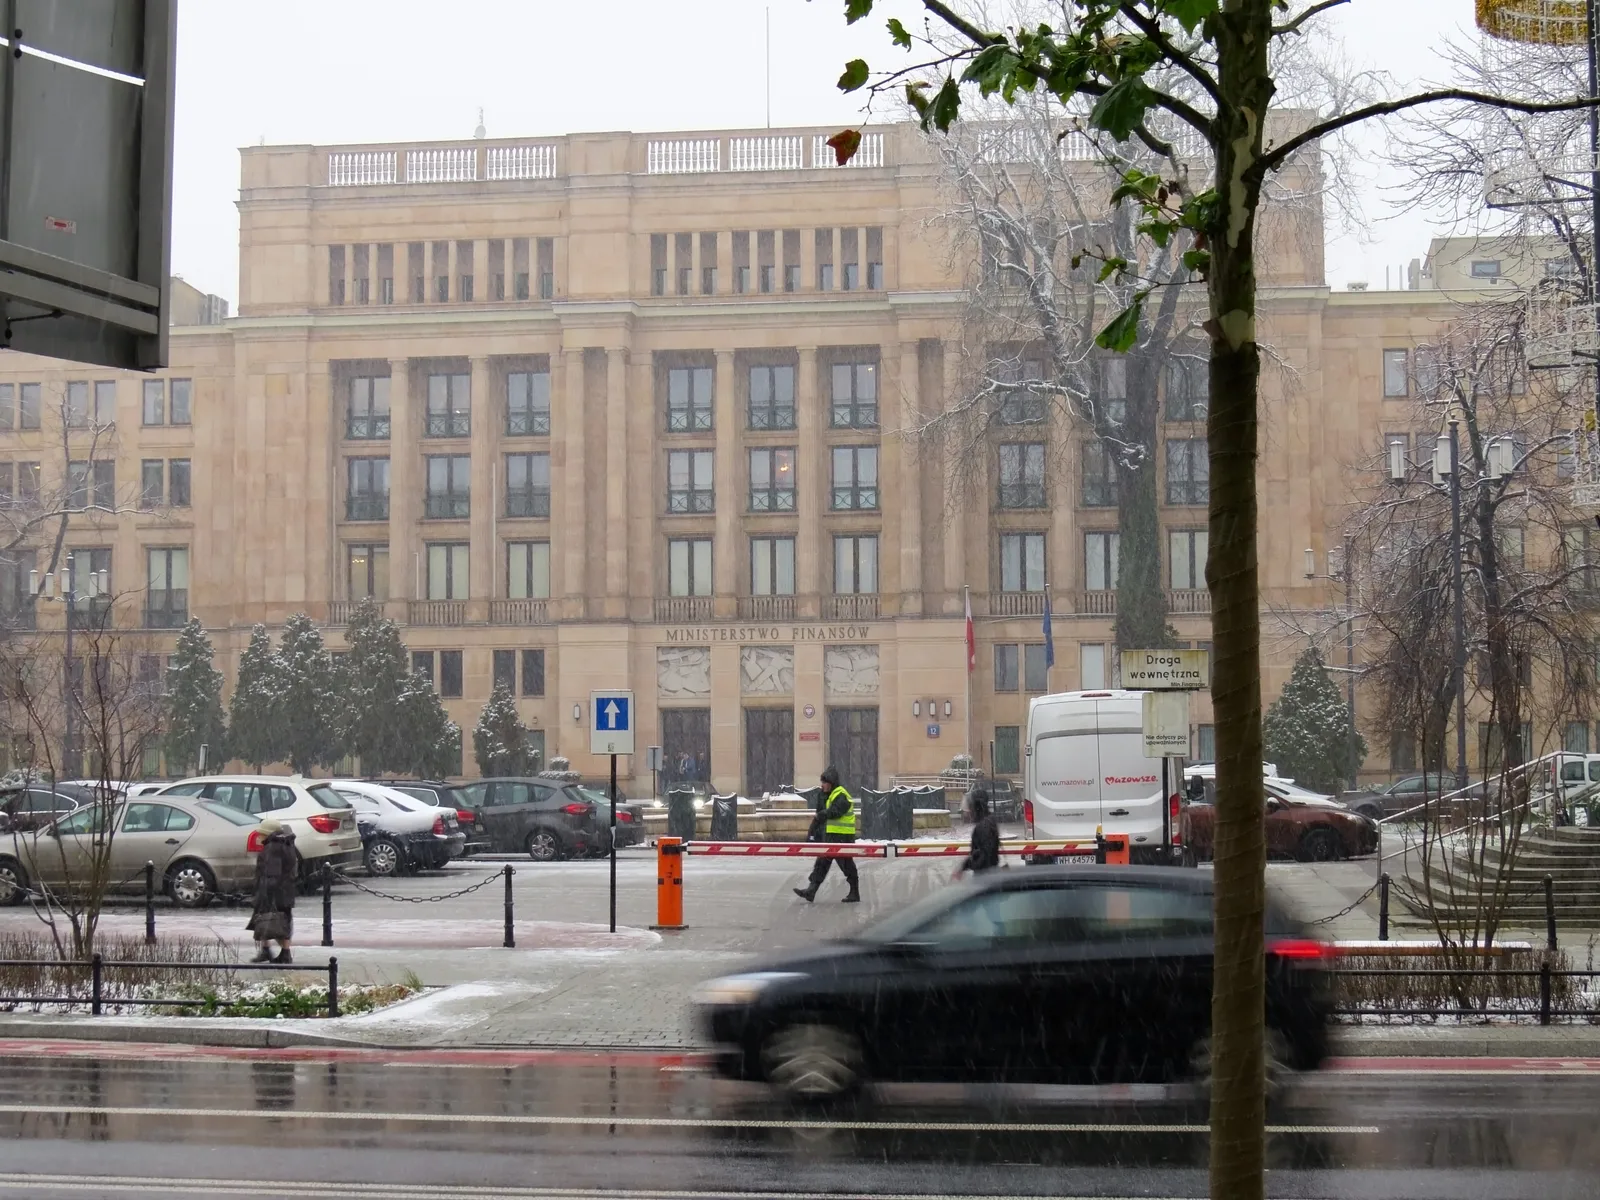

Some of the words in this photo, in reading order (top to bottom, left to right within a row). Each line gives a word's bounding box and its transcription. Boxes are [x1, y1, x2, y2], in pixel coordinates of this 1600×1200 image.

[666, 628, 779, 641] MINISTERSTWO
[792, 624, 869, 640] FINANSÓW
[1146, 655, 1181, 667] Droga
[1130, 669, 1200, 681] wewnętrzna
[1041, 778, 1094, 786] www.mazovia.pl
[1072, 855, 1095, 864] 64579
